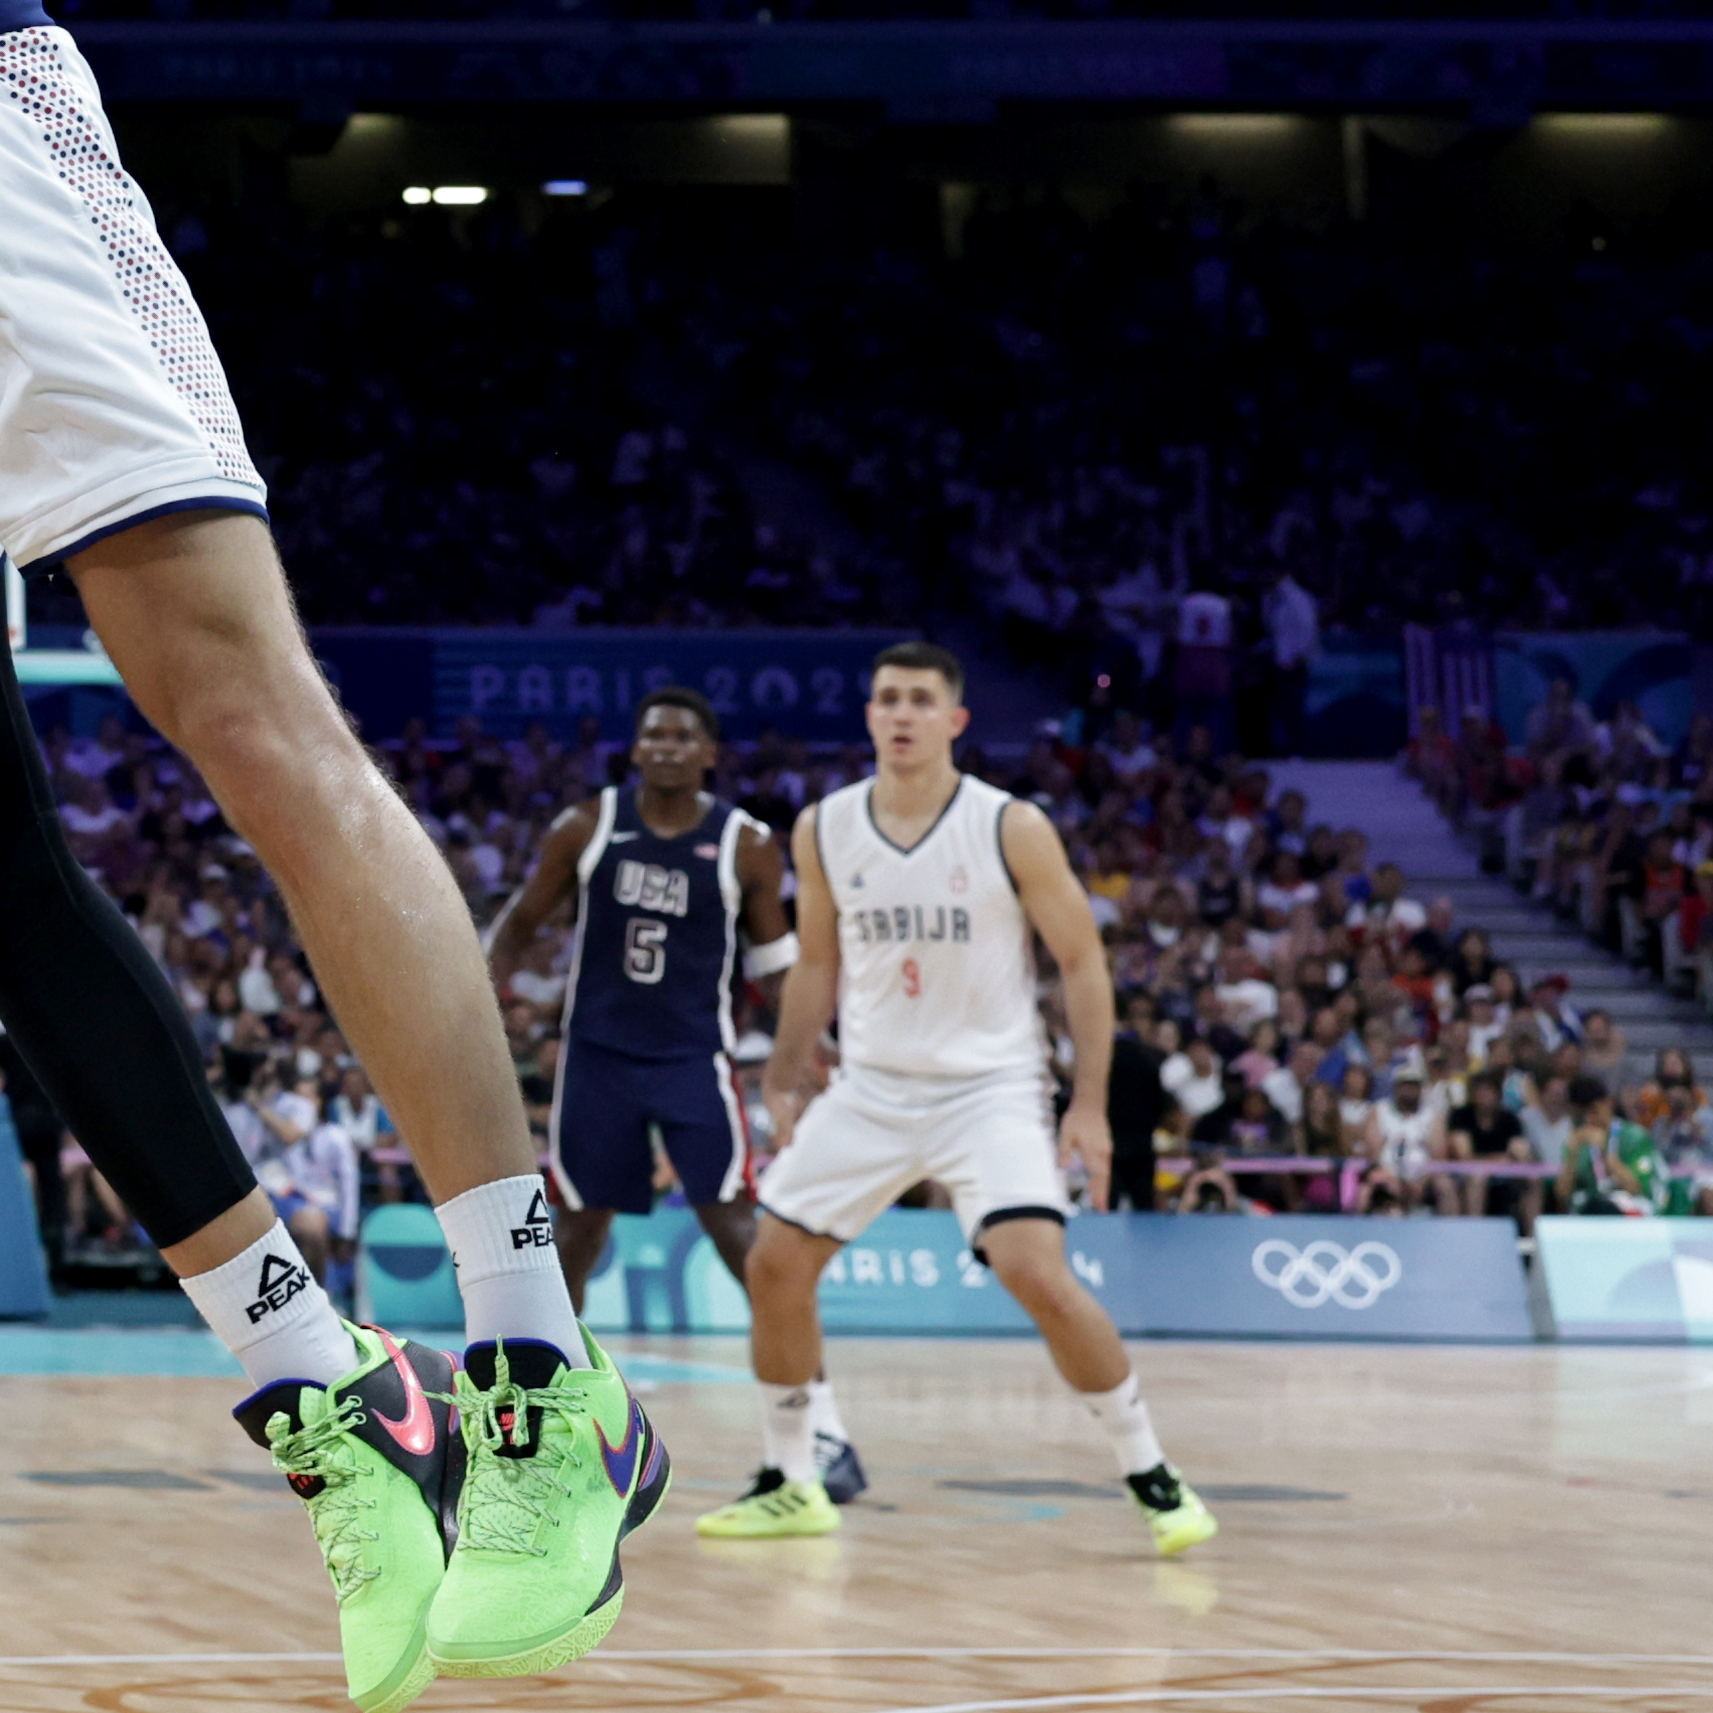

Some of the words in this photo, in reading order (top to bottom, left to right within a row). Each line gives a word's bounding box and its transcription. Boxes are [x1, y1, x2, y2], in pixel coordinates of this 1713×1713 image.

[613, 859, 690, 918] USA
[855, 904, 970, 943] SRBIJA
[623, 916, 668, 985] 5
[902, 956, 921, 999] 9
[823, 1248, 939, 1287] ARIS
[245, 1266, 310, 1324] PEAK
